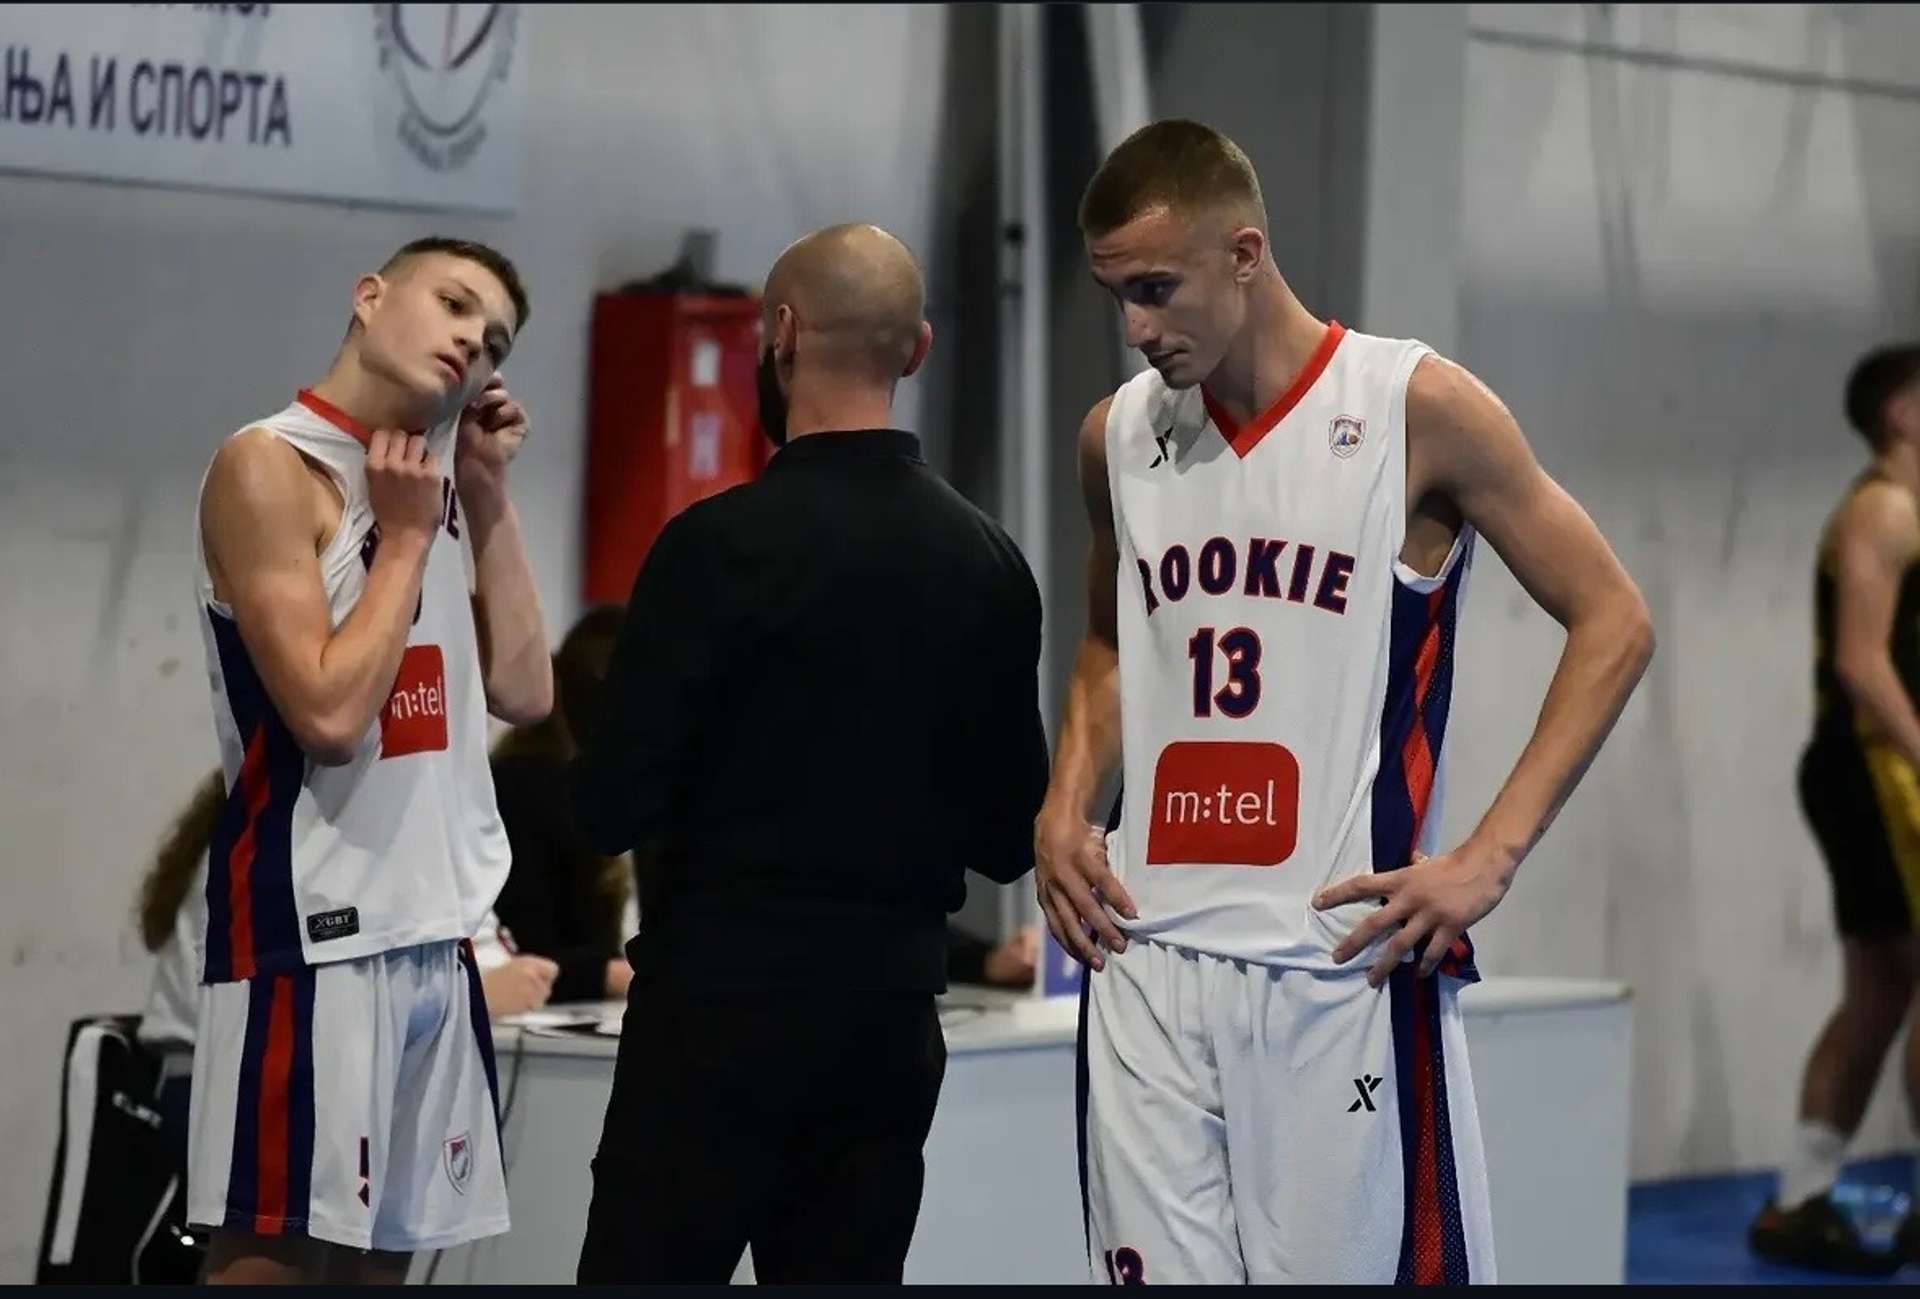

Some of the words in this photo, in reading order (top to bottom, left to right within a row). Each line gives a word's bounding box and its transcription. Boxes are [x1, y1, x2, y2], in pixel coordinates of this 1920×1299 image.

[0, 46, 75, 128] ЊА
[89, 57, 116, 130] И
[129, 61, 292, 147] СПОРТА
[1188, 626, 1262, 719] 13
[1164, 779, 1277, 826] m:tel
